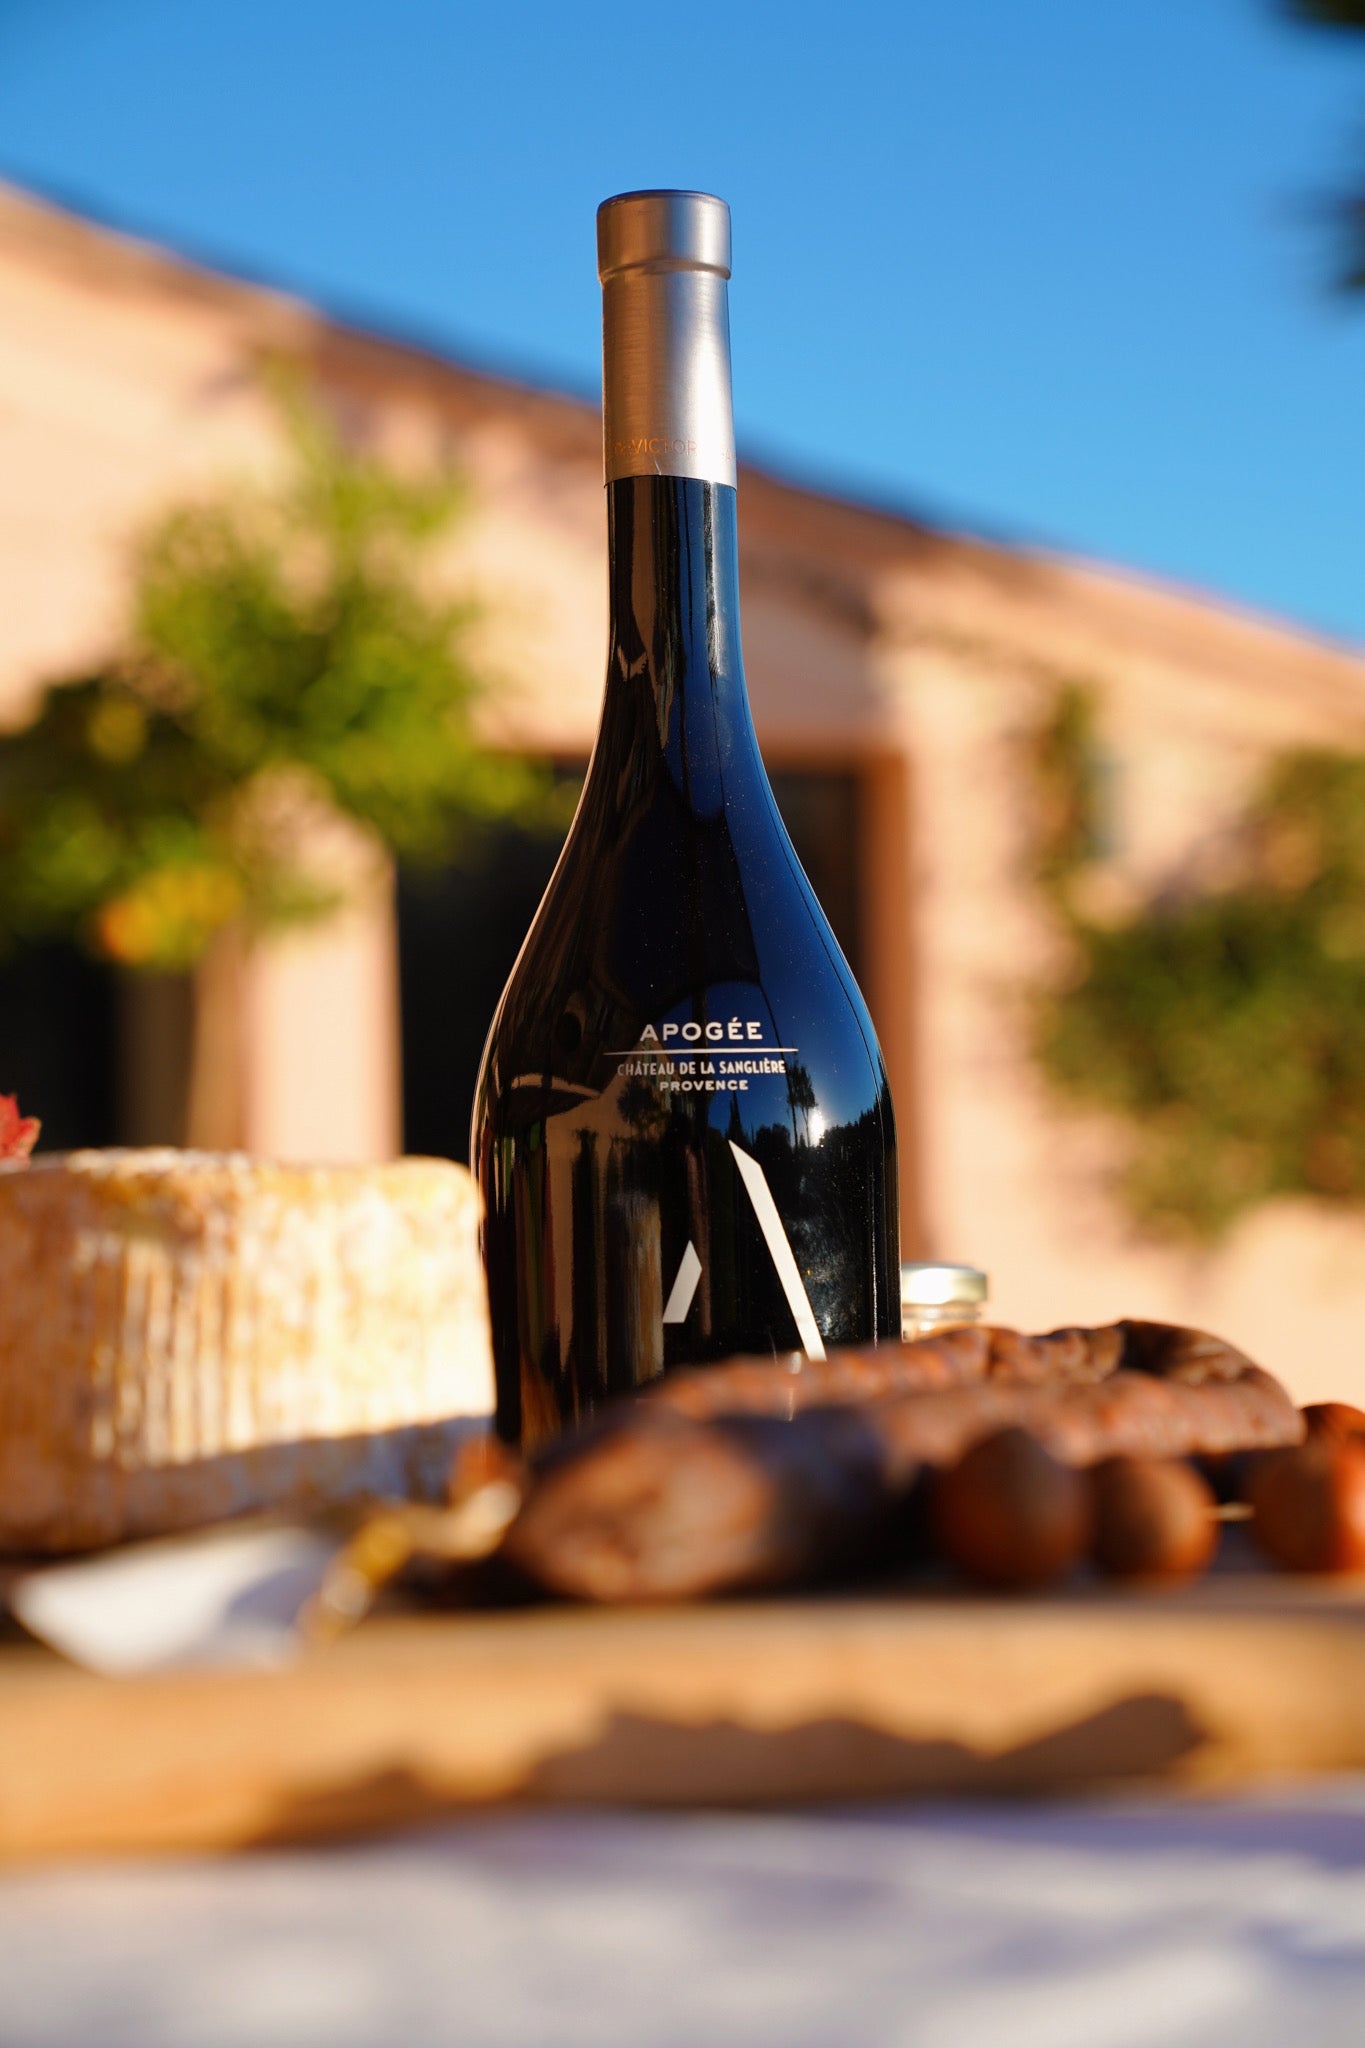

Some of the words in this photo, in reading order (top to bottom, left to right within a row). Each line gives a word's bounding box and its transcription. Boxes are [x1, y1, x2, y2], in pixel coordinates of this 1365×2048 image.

[640, 1016, 763, 1042] APOGÉE
[617, 1060, 675, 1076] CHÂTEAU
[679, 1061, 696, 1075] DE
[700, 1060, 715, 1075] LA
[719, 1057, 787, 1075] SANGLIÈRE
[659, 1079, 748, 1092] PROVENCE
